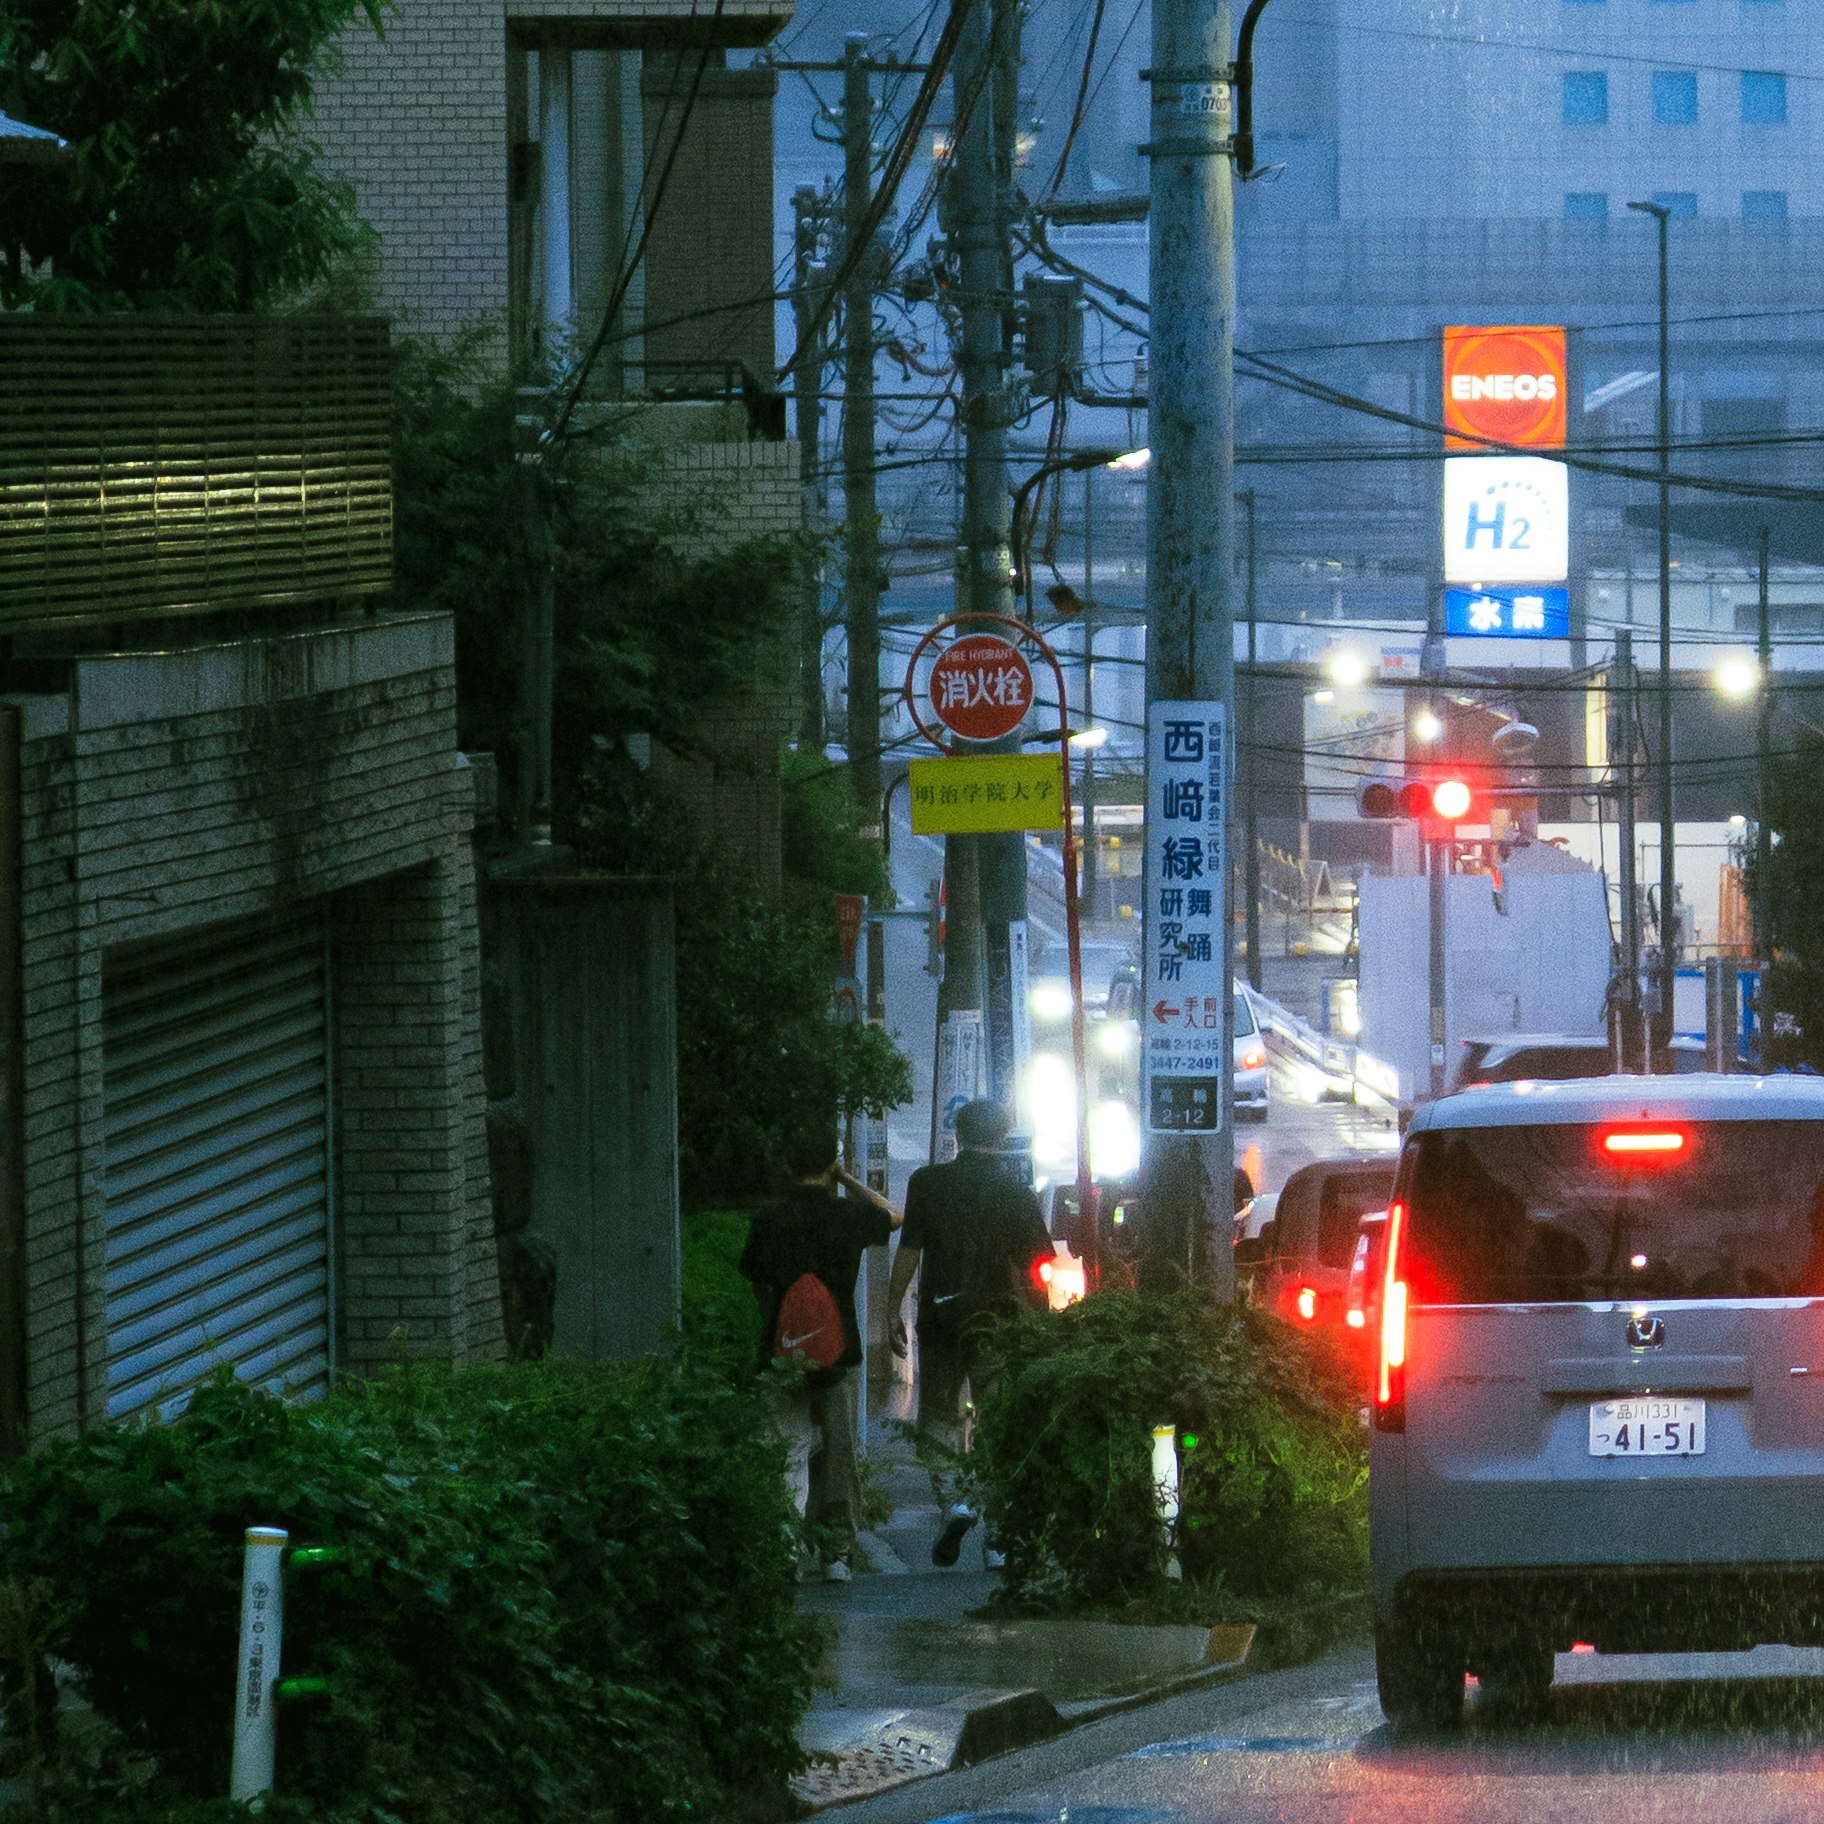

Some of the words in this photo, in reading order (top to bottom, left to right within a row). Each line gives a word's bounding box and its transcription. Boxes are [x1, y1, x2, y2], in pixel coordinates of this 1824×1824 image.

[1451, 374, 1556, 400] ENEOS
[1465, 502, 1531, 550] H2
[1469, 596, 1545, 630] 水素
[938, 666, 1025, 709] 消火栓
[915, 780, 1053, 805] 明治学院大学
[1162, 1109, 1205, 1124] 2-12
[1615, 1422, 1695, 1452] 41-51
